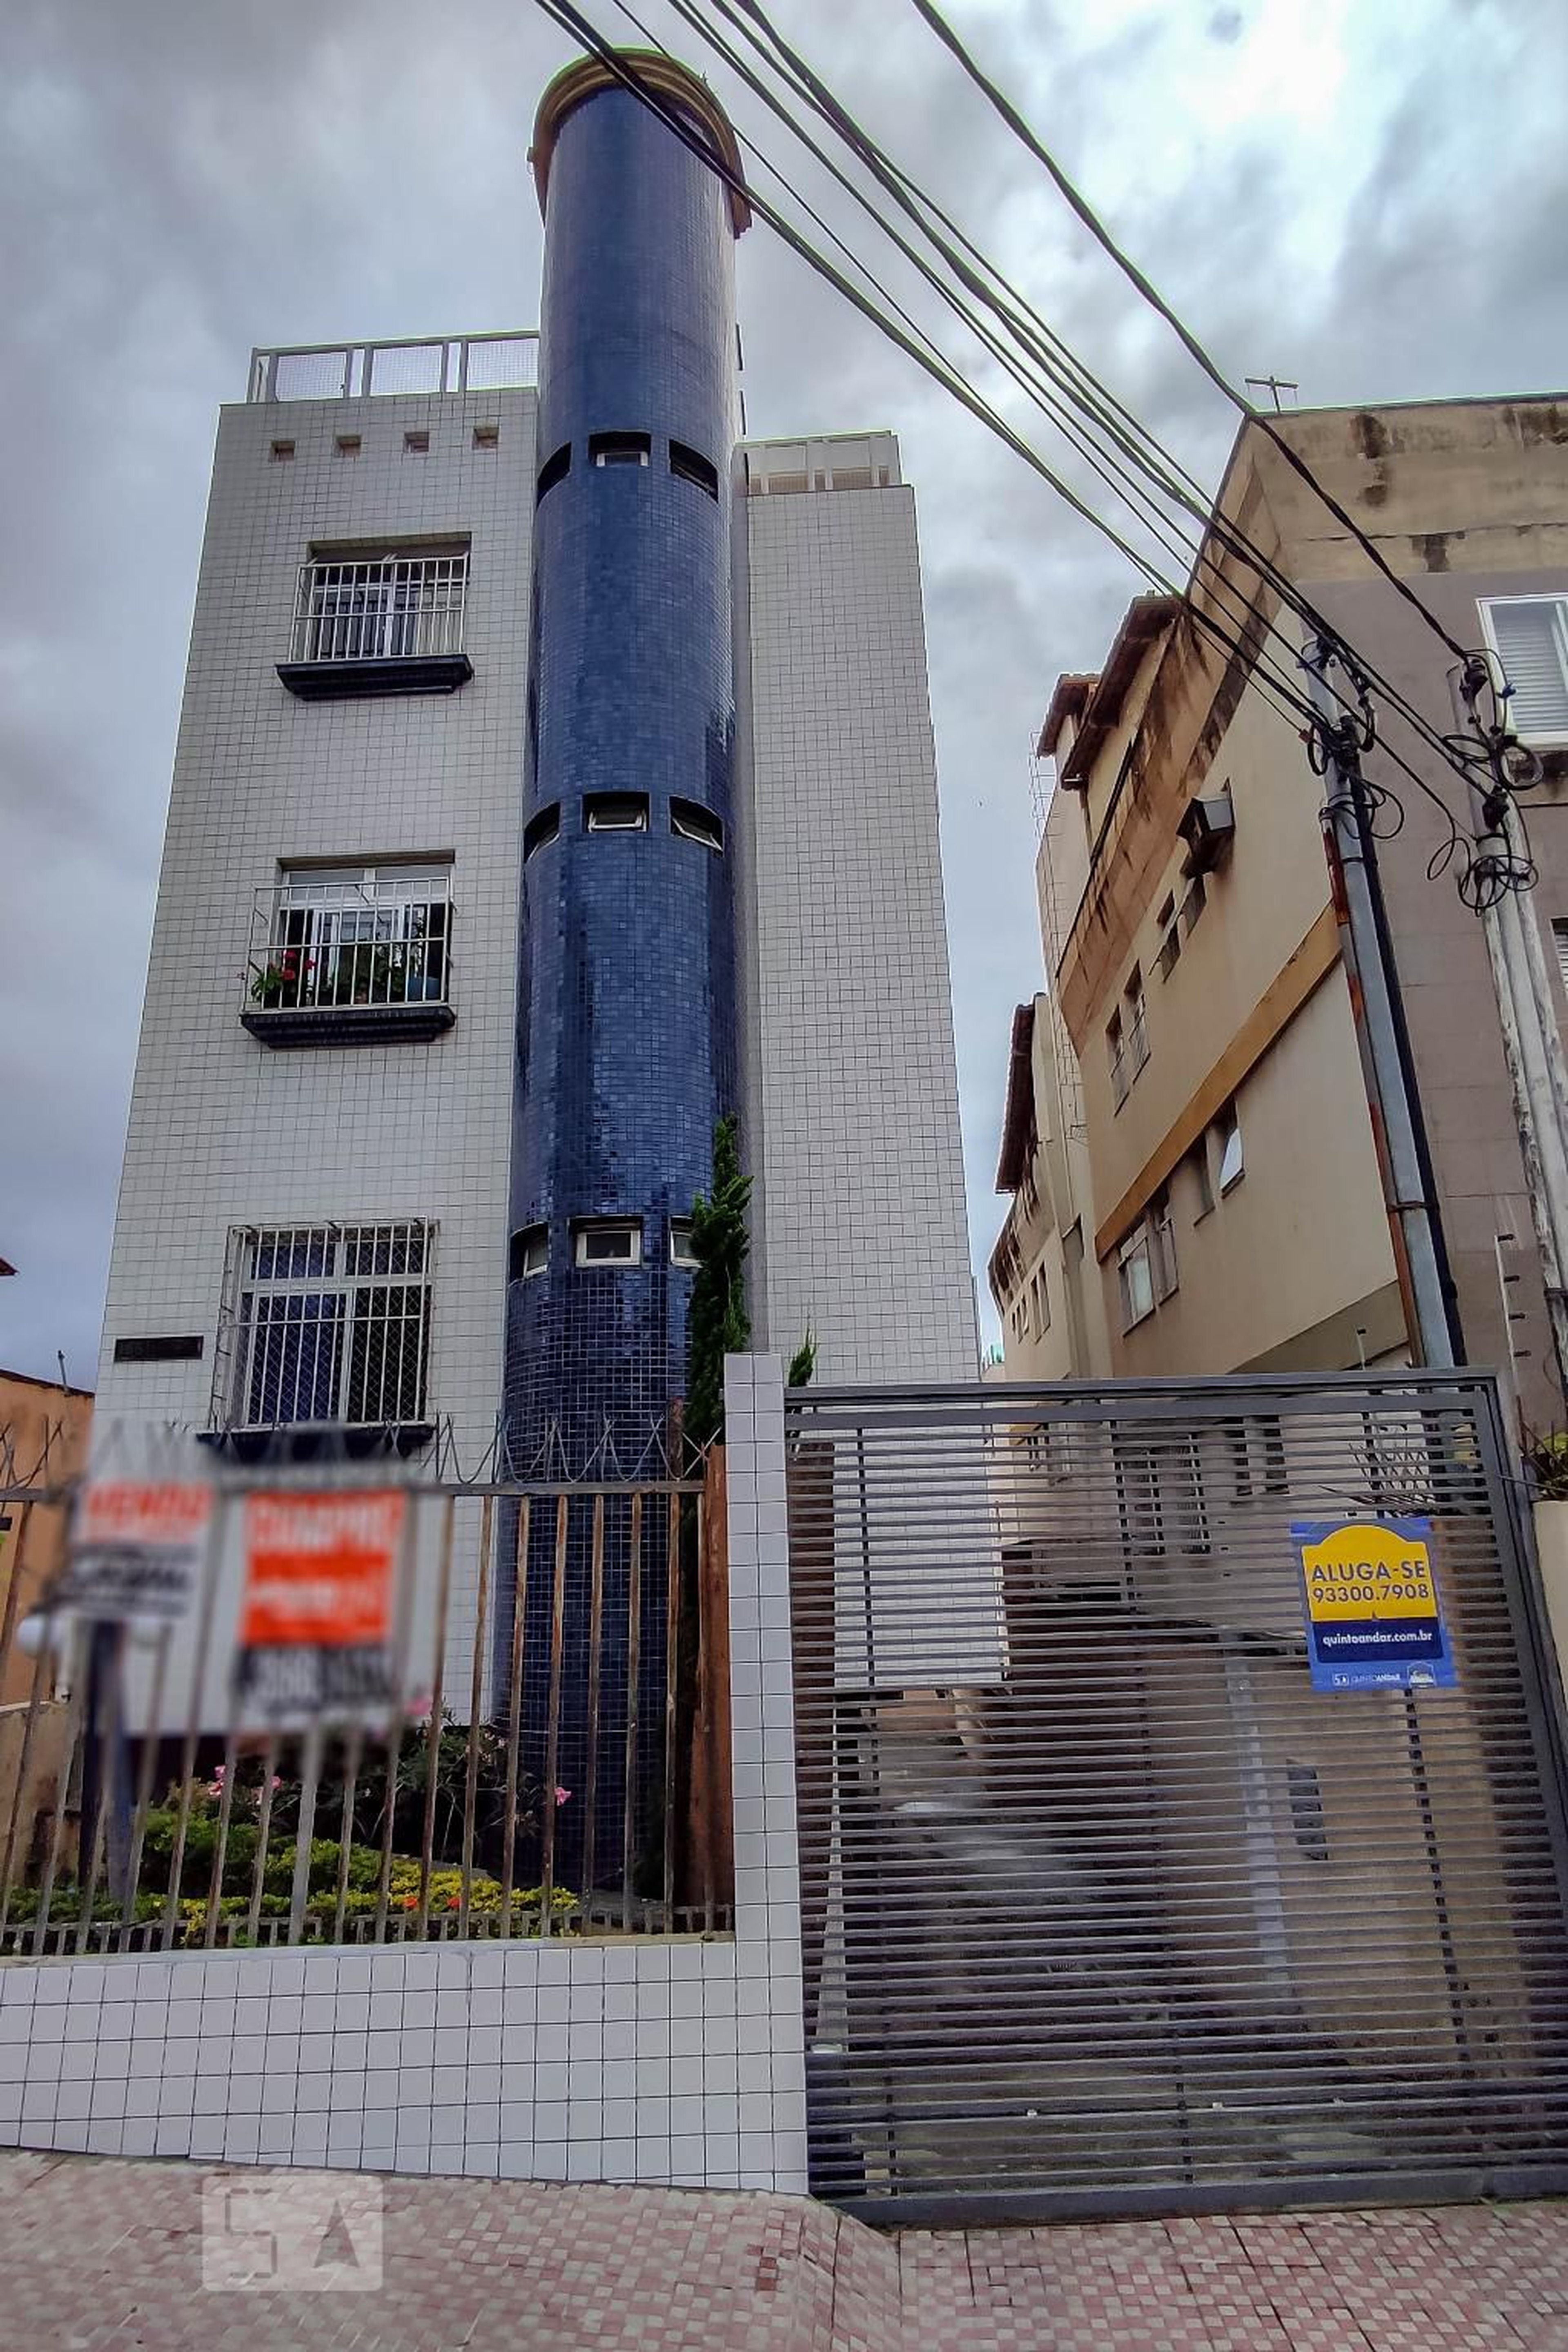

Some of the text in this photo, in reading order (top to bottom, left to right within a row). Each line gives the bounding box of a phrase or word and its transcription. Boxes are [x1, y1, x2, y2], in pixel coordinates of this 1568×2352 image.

[1312, 1560, 1426, 1582] ALUGA-SE
[1312, 1584, 1429, 1603] 93300.7908
[1323, 1630, 1432, 1647] quintoandar.com.br
